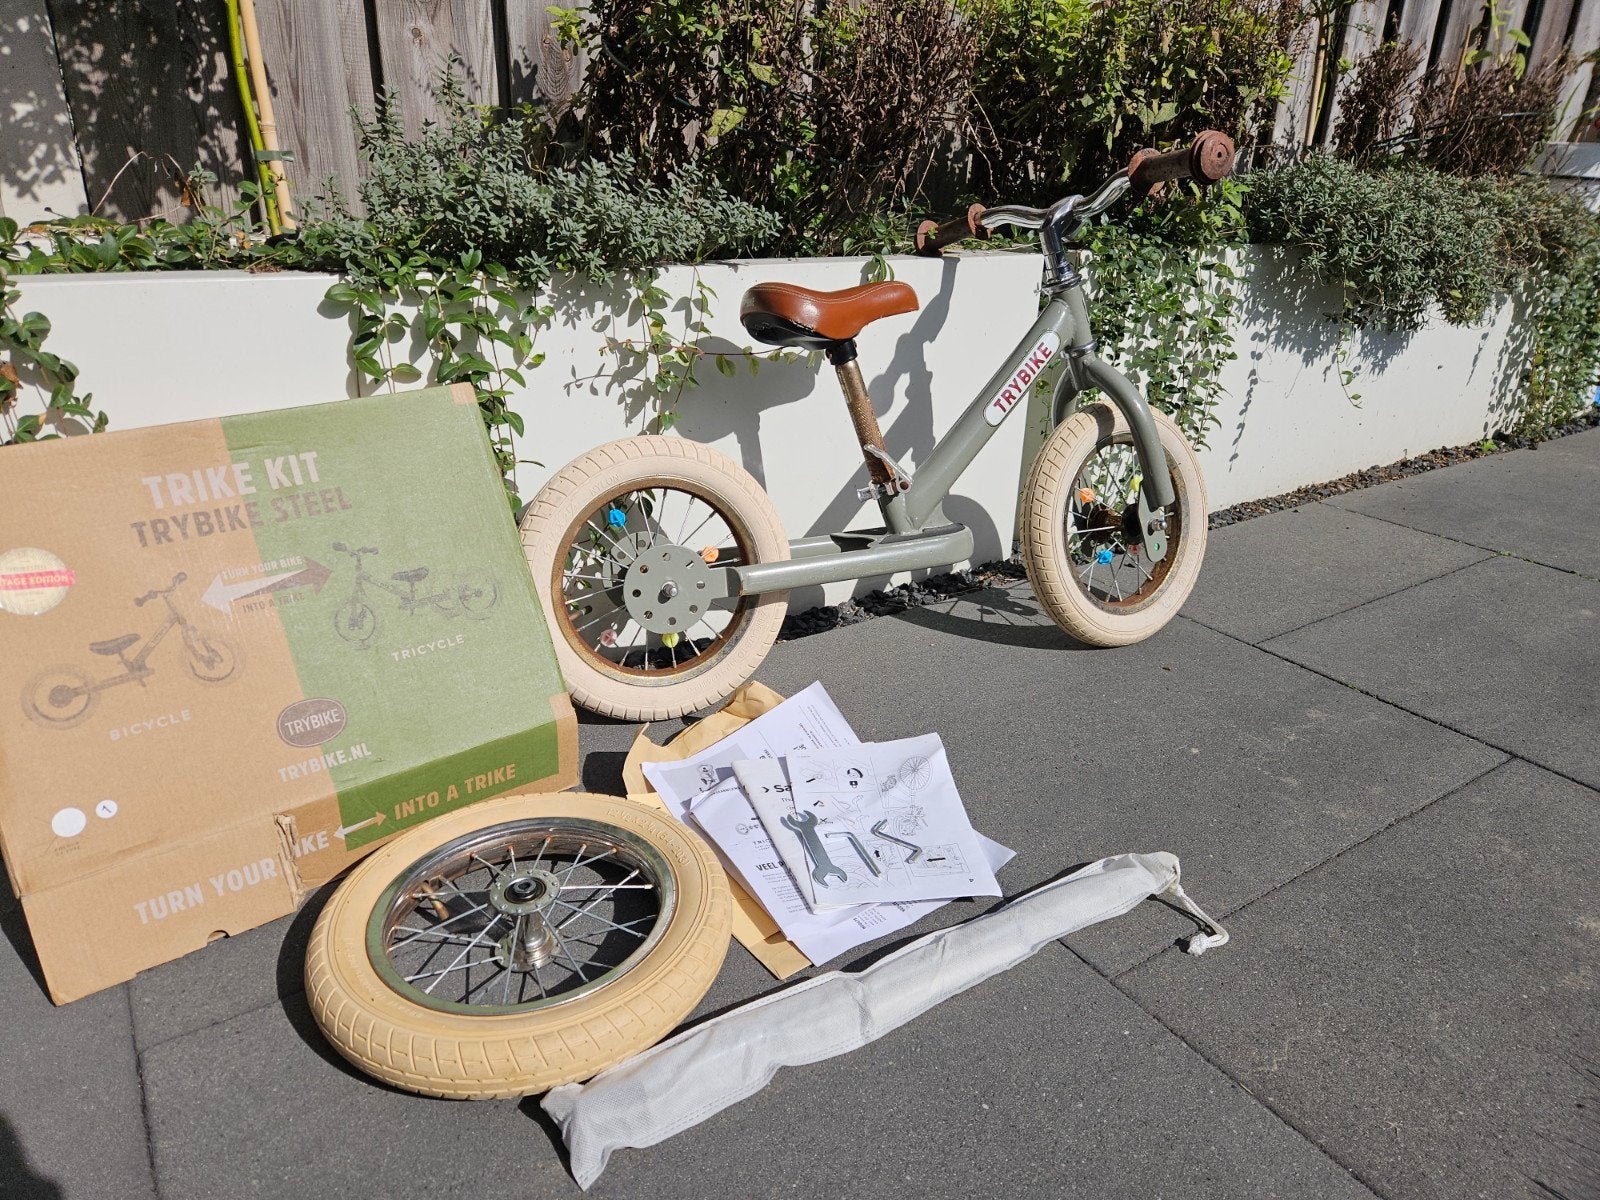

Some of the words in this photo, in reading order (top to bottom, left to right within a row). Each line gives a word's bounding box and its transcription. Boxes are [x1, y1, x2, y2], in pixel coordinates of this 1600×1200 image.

[993, 342, 1052, 413] TRYBIKE
[142, 462, 256, 509] TRIKE
[264, 451, 319, 490] KIT
[130, 501, 264, 548] TRYBIKE
[270, 486, 352, 523] STEEL
[0, 577, 26, 586] TAGE
[29, 574, 68, 585] EDITION
[221, 567, 249, 580] TURN
[251, 561, 280, 574] YOUR
[279, 556, 303, 568] BIKE
[242, 600, 265, 613] INTO
[391, 634, 465, 662] TRICYCLE
[109, 709, 192, 741] BICYCLE
[284, 708, 341, 736] TRYBIKE
[277, 743, 372, 782] TRYBIKE.NL
[394, 791, 439, 820] INTO
[446, 784, 459, 802] A
[464, 763, 516, 794] TRIKE
[134, 882, 204, 925] TURN
[208, 858, 277, 897] YOUR
[294, 831, 330, 858] IKE
[756, 862, 779, 871] VEEL
